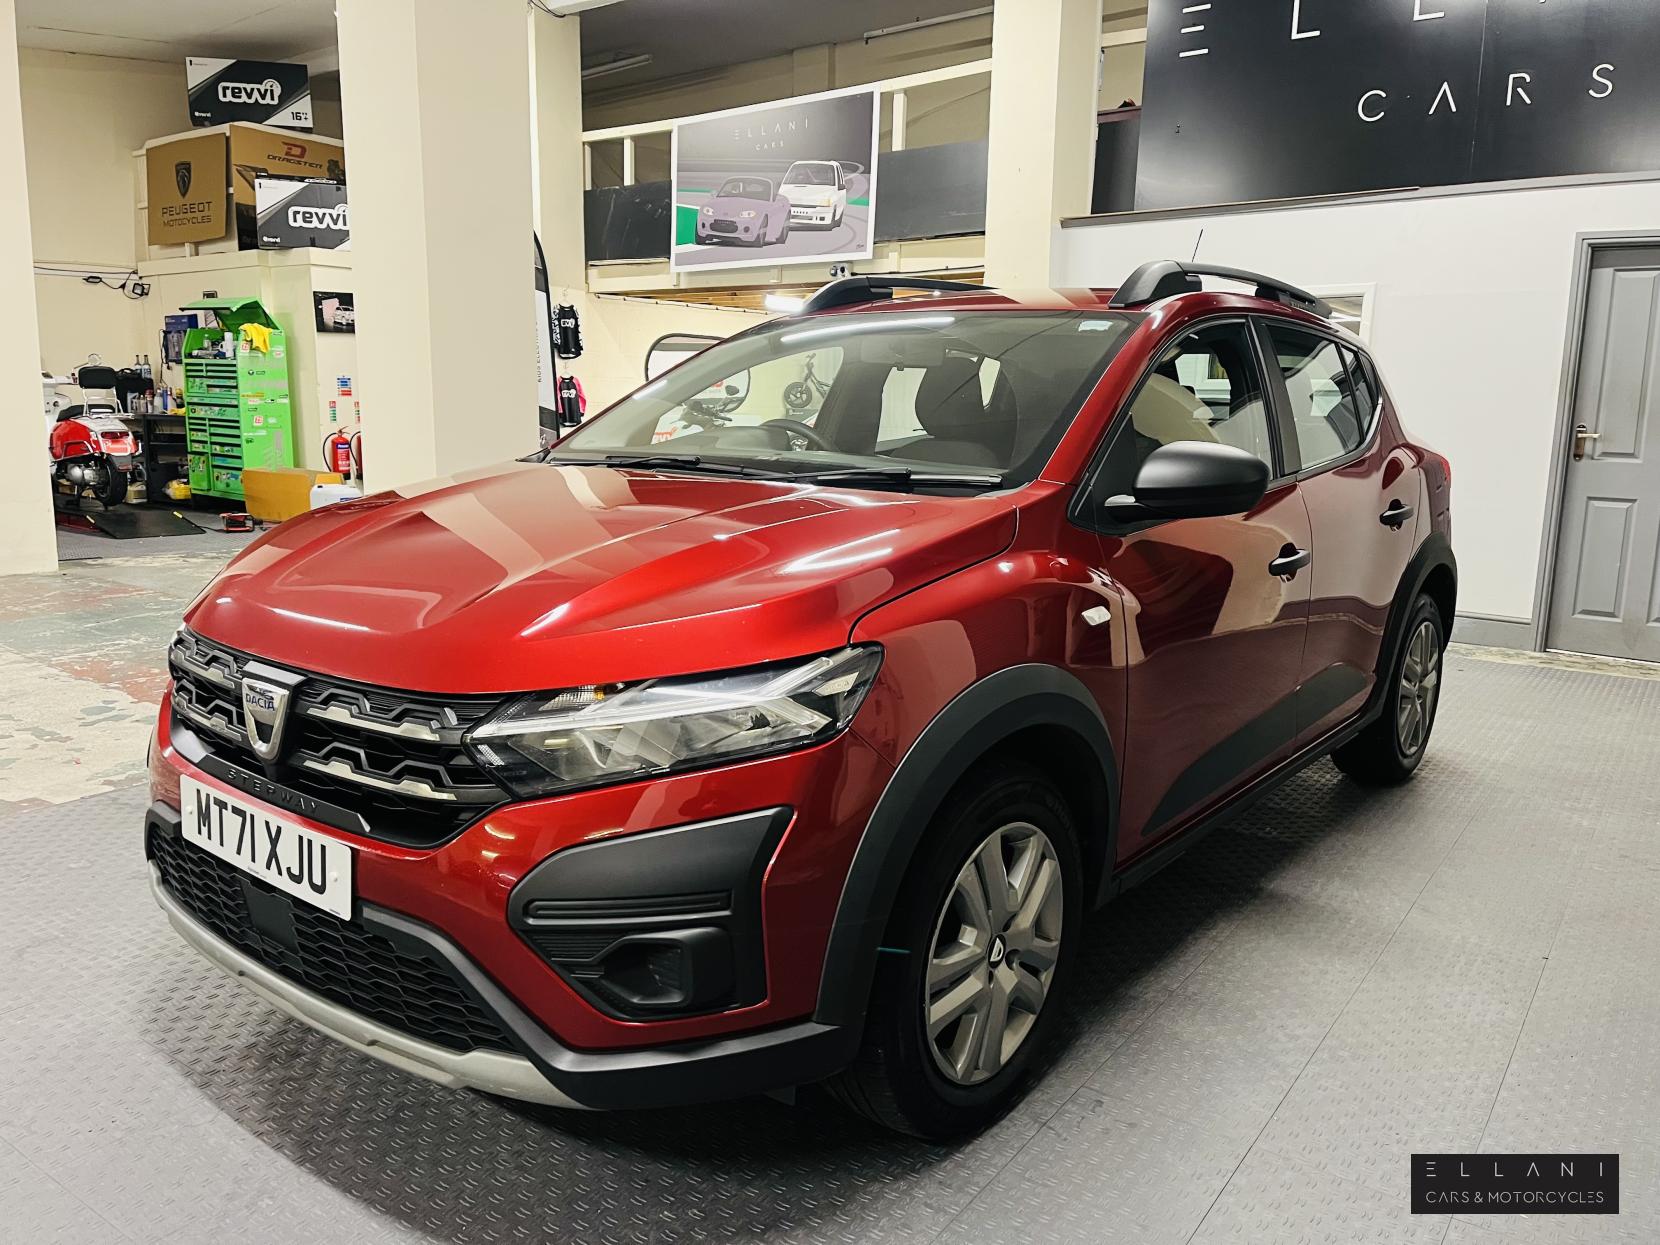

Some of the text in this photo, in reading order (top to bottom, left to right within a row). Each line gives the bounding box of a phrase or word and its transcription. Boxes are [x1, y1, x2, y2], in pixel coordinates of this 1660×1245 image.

[220, 82, 277, 102] revvi
[1357, 62, 1615, 122] CARS
[734, 115, 809, 140] ELLANI
[755, 140, 784, 151] CARS
[267, 154, 323, 169] DRAGSTER
[161, 201, 213, 217] PEUGEOT
[290, 207, 348, 228] revvi
[245, 694, 276, 712] DACIA
[227, 768, 319, 814] STEPWAY
[196, 788, 327, 895] MT71 XJU
